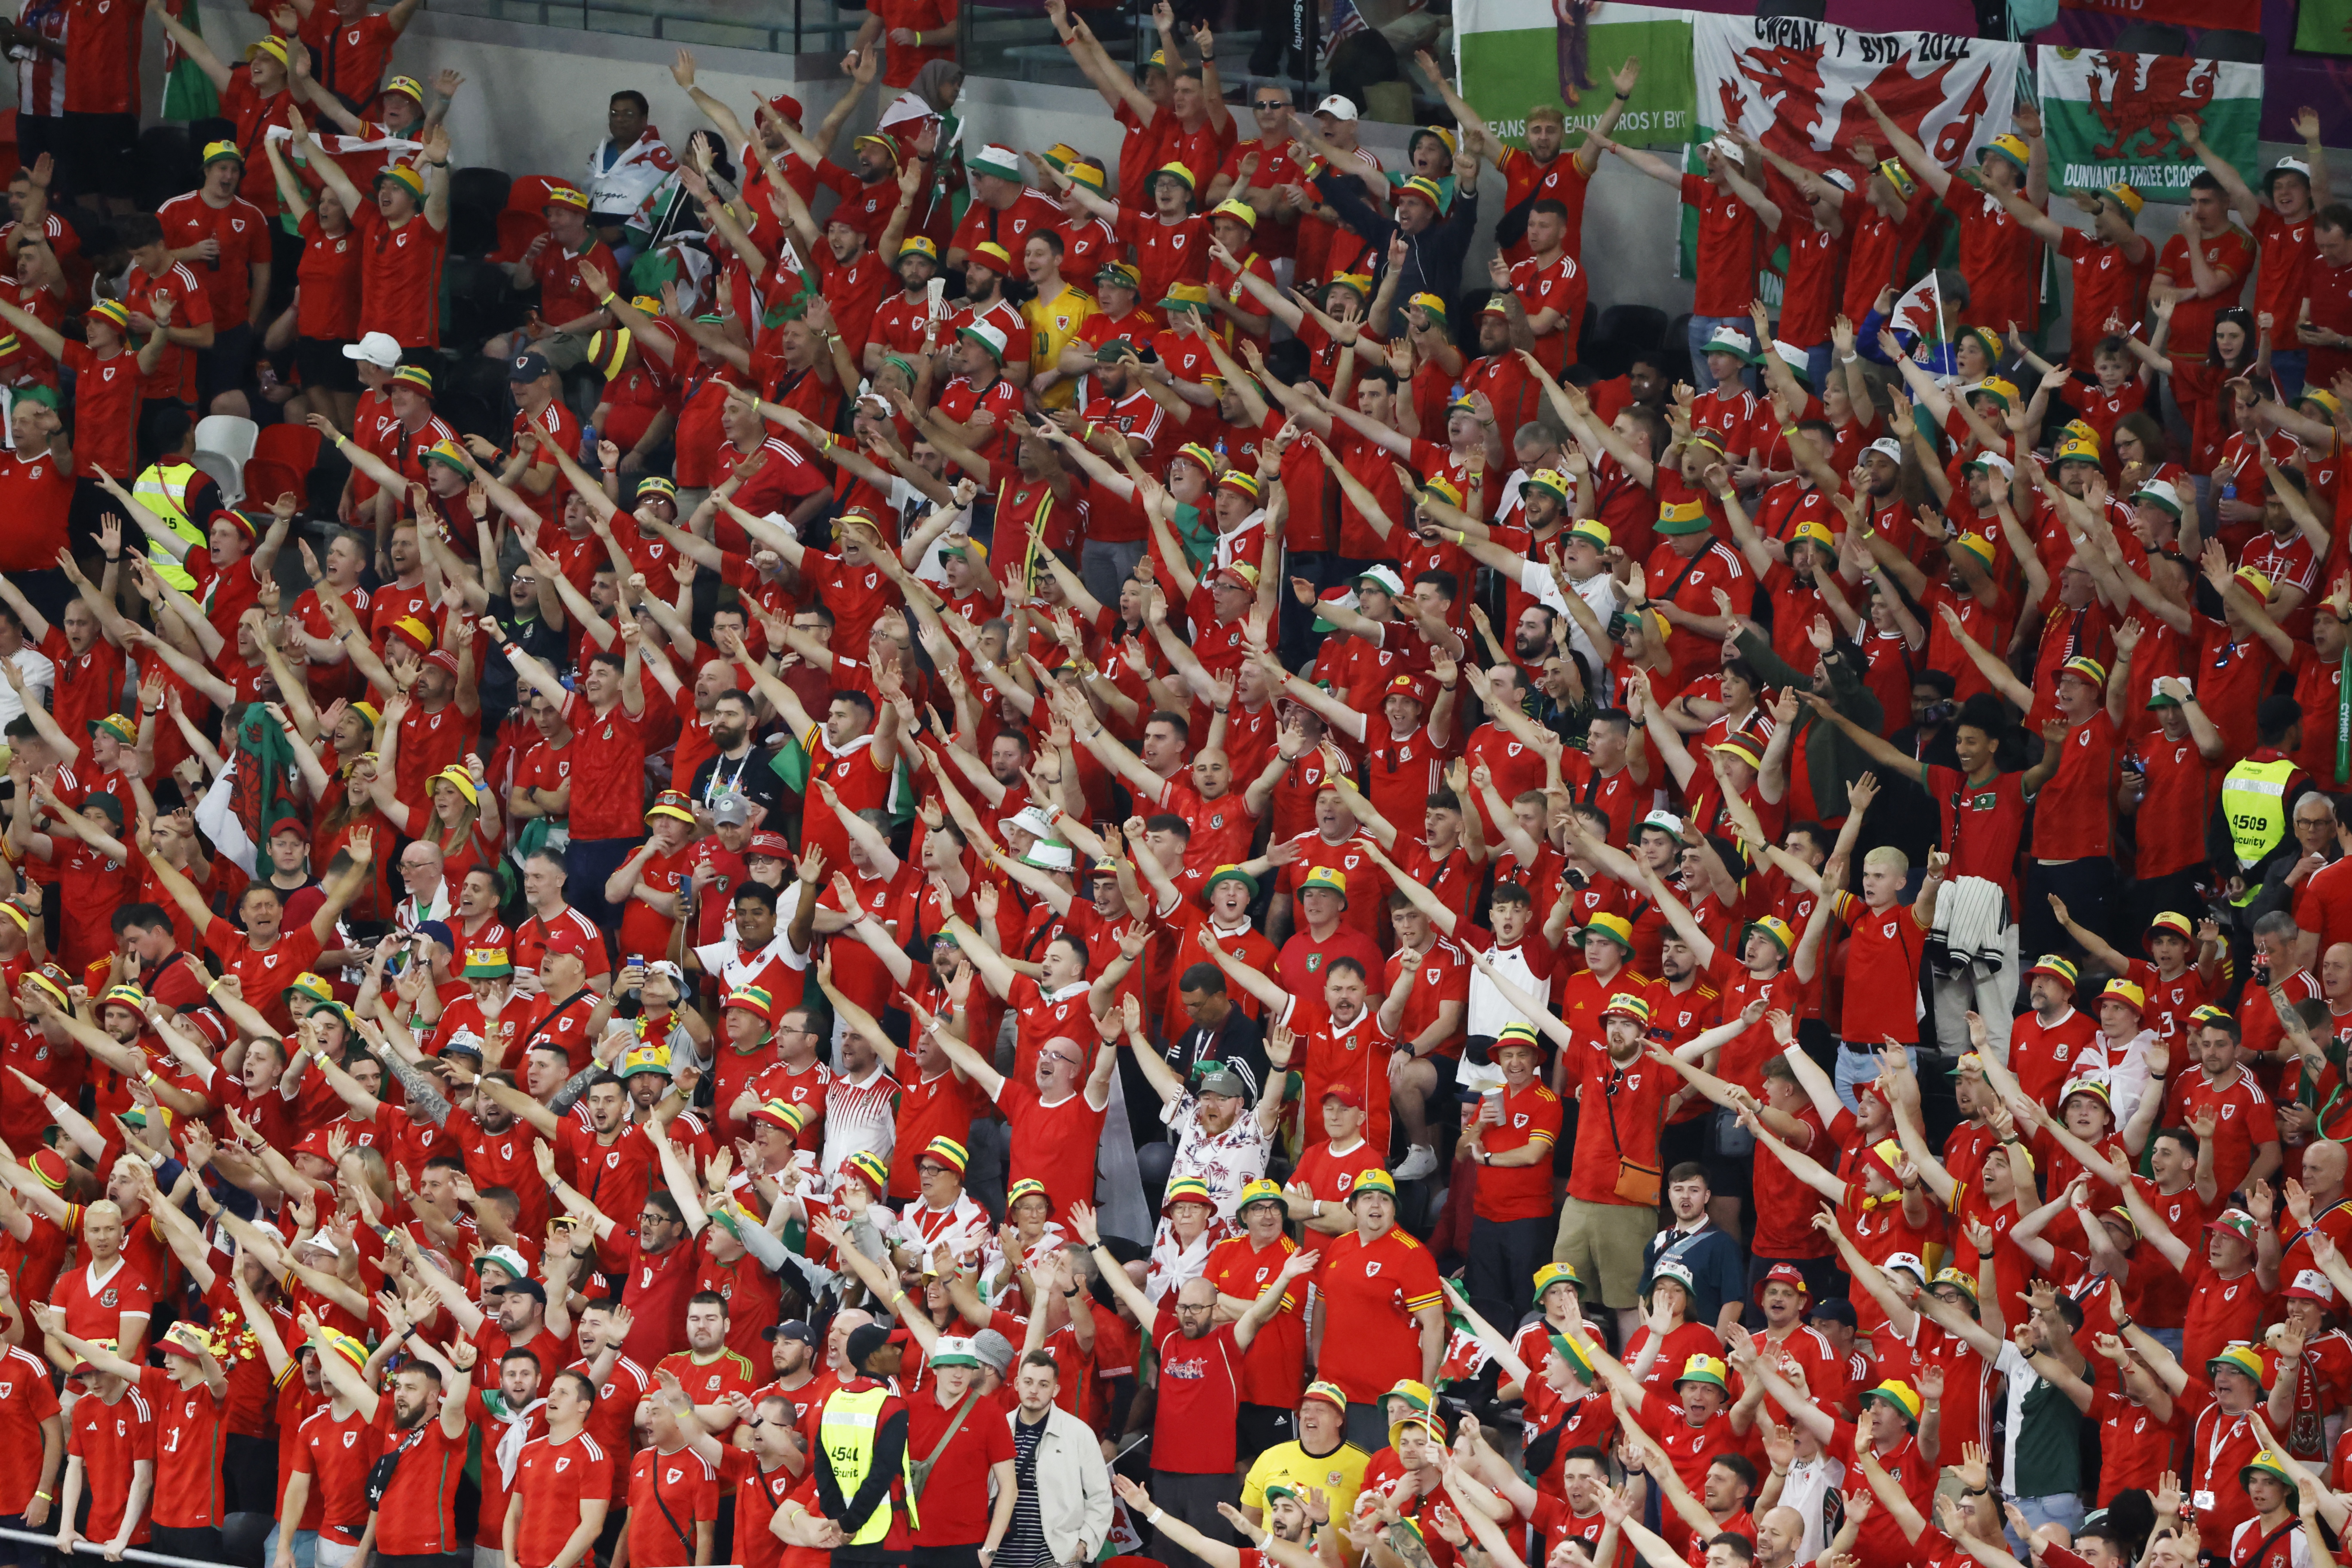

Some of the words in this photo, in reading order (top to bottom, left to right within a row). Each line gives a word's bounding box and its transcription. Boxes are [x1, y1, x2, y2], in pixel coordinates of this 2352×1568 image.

[1755, 16, 1818, 53] CWPAN
[1836, 28, 1846, 57] Y
[1859, 36, 1899, 63] BYD
[1918, 33, 1970, 61] 2022
[1485, 119, 1525, 138] EANS
[1563, 114, 1603, 134] EAUX
[1613, 111, 1650, 131] ROS
[1652, 111, 1660, 129] Y
[2064, 164, 2117, 188] DUNVANT
[2118, 166, 2126, 184] &
[2130, 165, 2163, 187] THREE
[2164, 165, 2207, 187] CROS
[162, 517, 177, 530] 15
[2340, 702, 2350, 742] CYMRU
[2233, 814, 2267, 831] 4509
[2235, 836, 2266, 848] ecurity
[1172, 1086, 1182, 1102] HYD
[641, 1267, 652, 1288] 9
